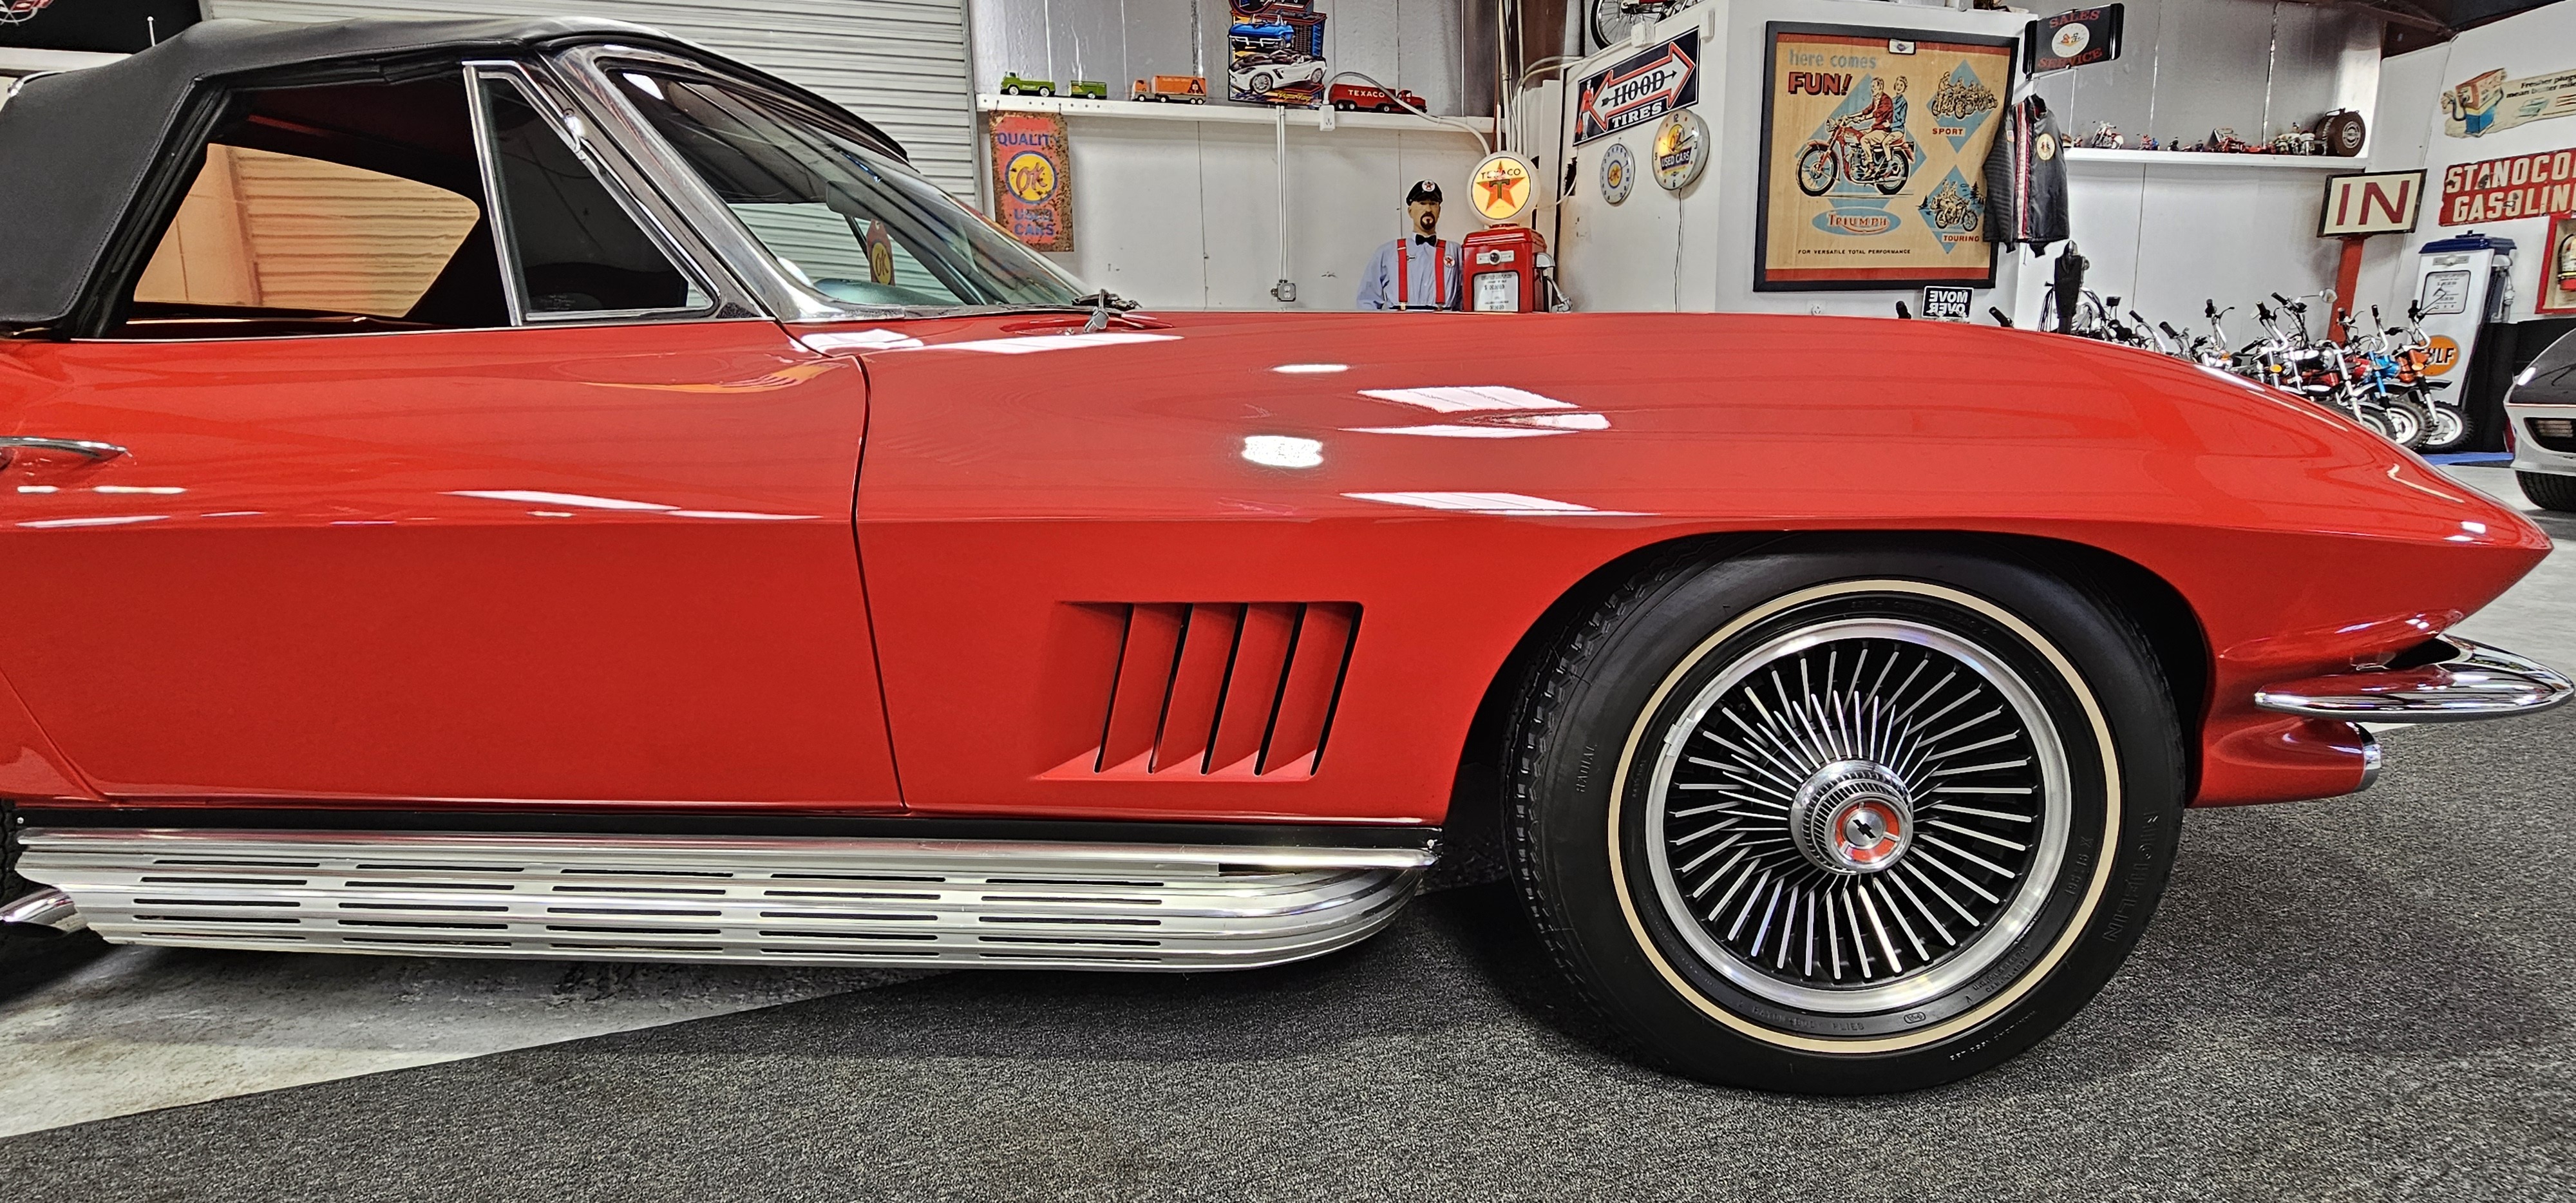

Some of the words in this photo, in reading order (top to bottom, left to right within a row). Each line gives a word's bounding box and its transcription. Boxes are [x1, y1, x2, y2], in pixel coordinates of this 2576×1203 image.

[2050, 10, 2101, 28] SALES
[1789, 48, 1824, 66] here
[1830, 55, 1877, 69] comes
[2038, 47, 2103, 68] SERVICE
[1348, 89, 1385, 98] TEXACO
[1613, 70, 1665, 108] HOOD
[1788, 71, 1853, 95] FUN!
[1612, 102, 1662, 128] TIRES
[1662, 154, 1674, 167] USED
[1676, 150, 1690, 164] CARS
[1016, 162, 1048, 193] OK
[2446, 152, 2576, 193] STANOCO
[2336, 180, 2410, 225] IN
[1828, 213, 1889, 229] TRIUMPH
[2425, 347, 2456, 365] ULF
[1575, 743, 1598, 793] RADIAL
